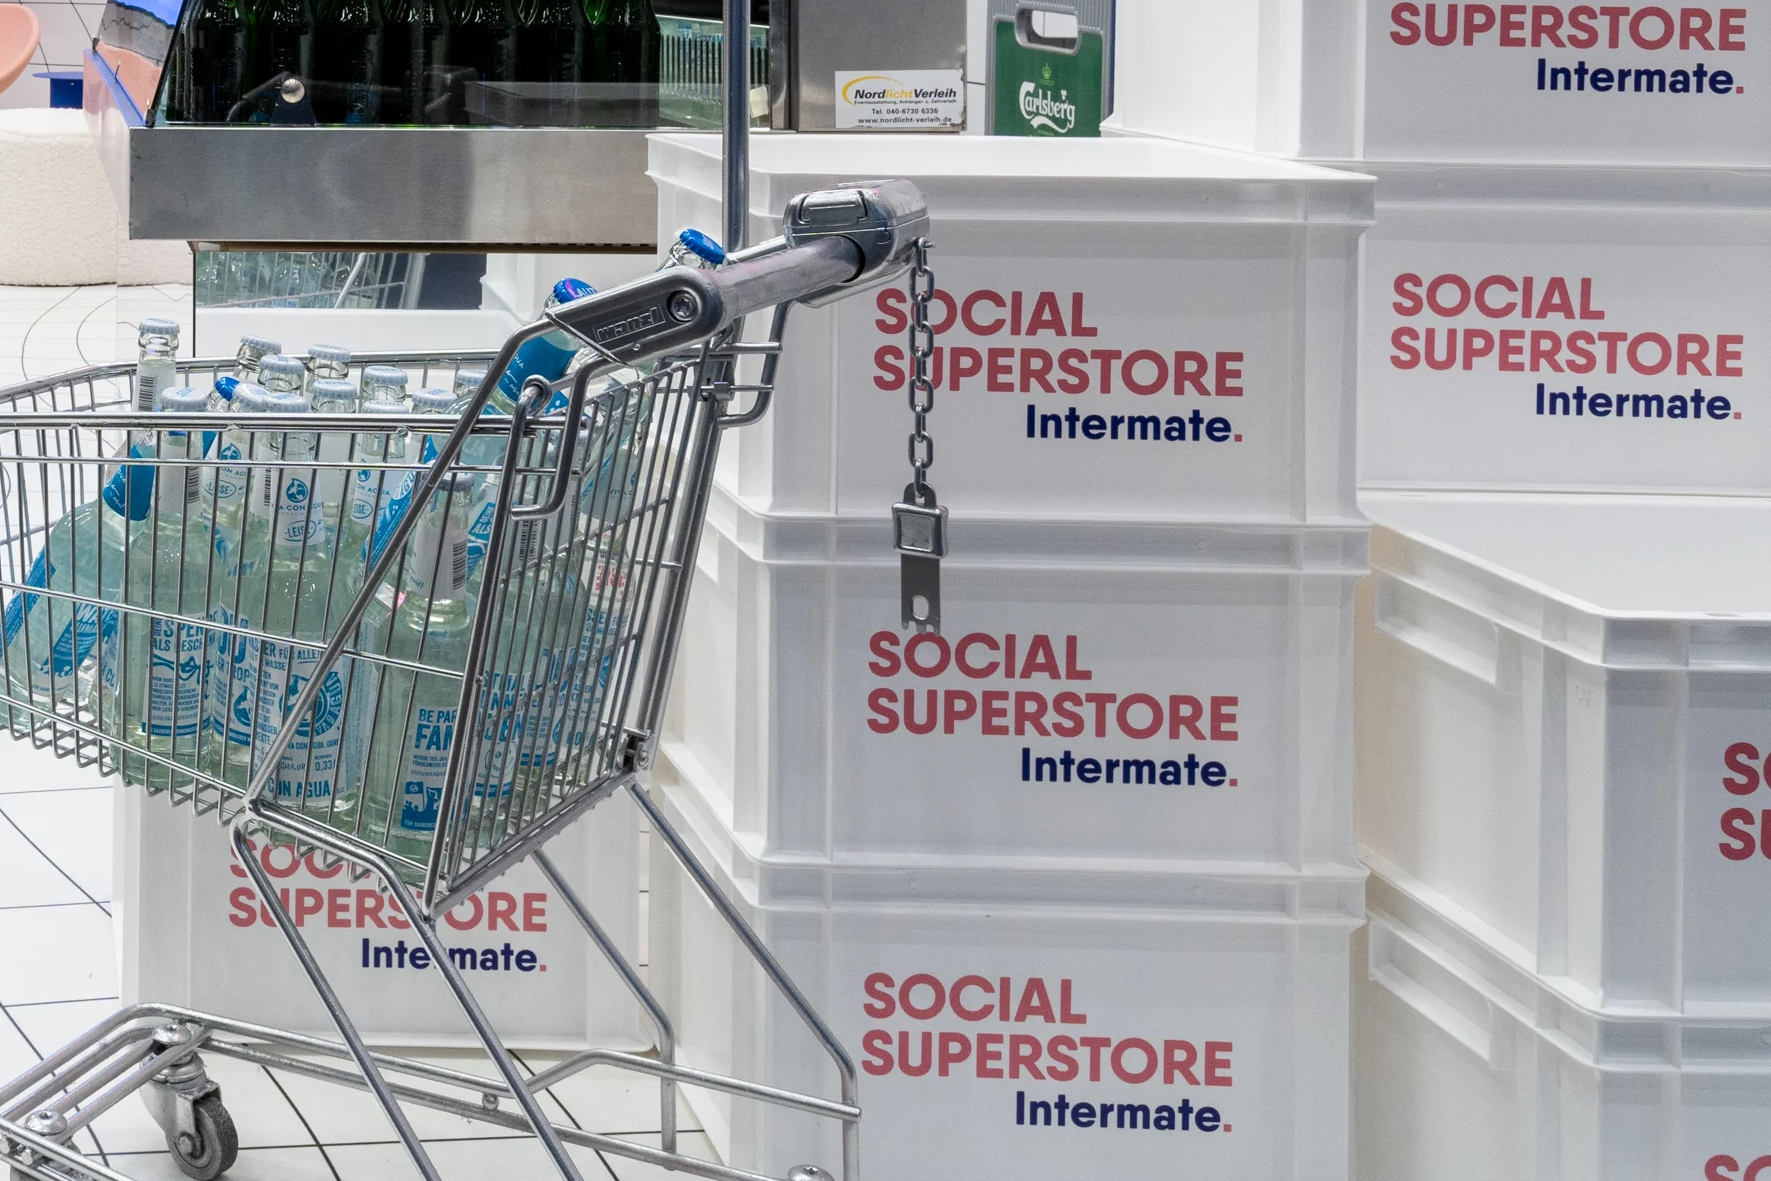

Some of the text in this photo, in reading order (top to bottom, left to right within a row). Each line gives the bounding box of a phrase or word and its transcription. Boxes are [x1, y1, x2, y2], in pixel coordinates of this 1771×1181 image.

[1391, 3, 1747, 51] SUPERSTORE
[1537, 59, 1746, 95] Intermate.
[1019, 80, 1076, 131] Carlsberg
[876, 287, 1098, 338] SOCIAL
[1393, 272, 1606, 321] SOCIAL
[874, 346, 1244, 398] SUPERSTORE
[1390, 326, 1744, 378] SUPERSTORE
[1026, 404, 1244, 444] Intermate.
[1536, 383, 1744, 421] Intermate.
[870, 630, 1092, 681] SOCIAL
[418, 708, 434, 723] BE
[868, 688, 1239, 742] SUPERSTORE
[1021, 748, 1239, 788] Intermate.
[361, 938, 548, 972] Intemate.
[864, 972, 1087, 1024] SOCIAL
[862, 1029, 1233, 1087] SUPERSTORE
[1016, 1091, 1233, 1134] Intermate.
